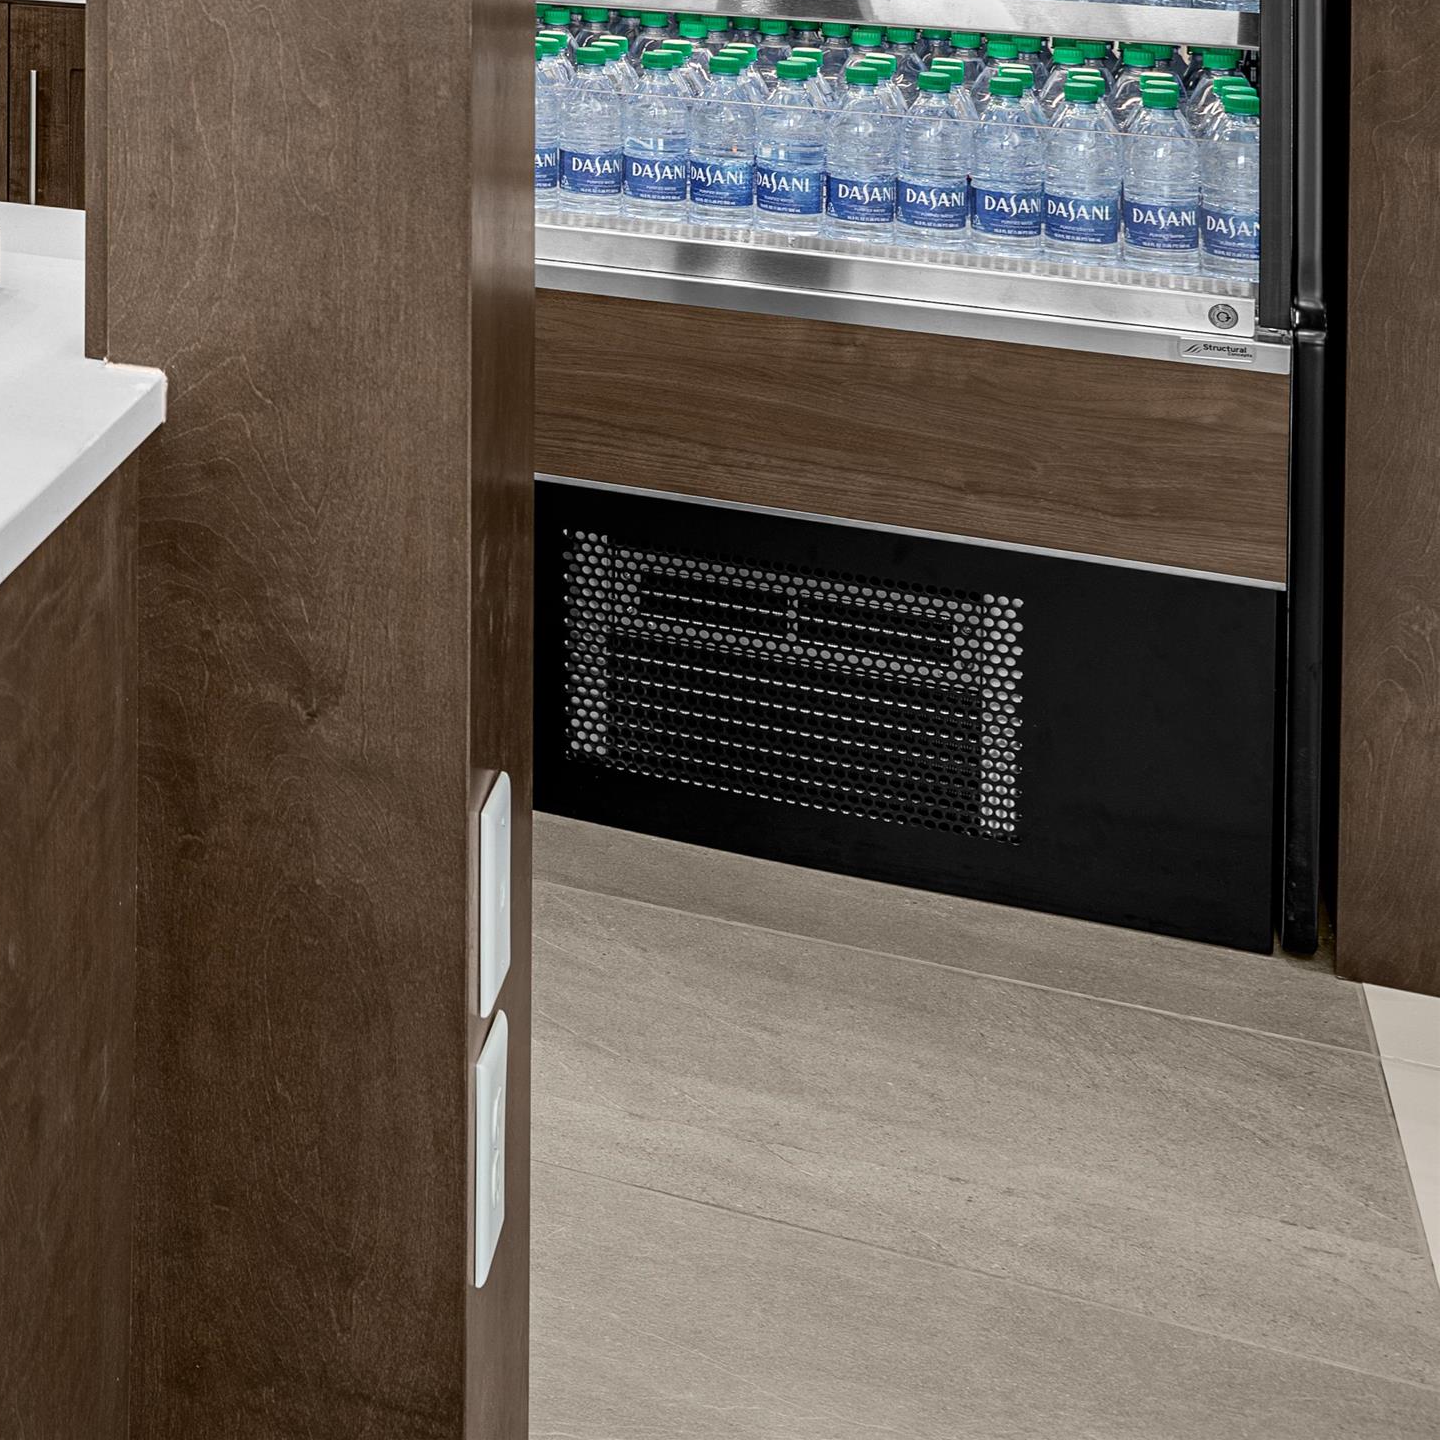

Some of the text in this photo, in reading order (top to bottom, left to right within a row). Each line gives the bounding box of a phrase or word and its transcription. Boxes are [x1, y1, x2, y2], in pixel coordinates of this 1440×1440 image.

[691, 164, 744, 185] DASANI
[1048, 198, 1109, 220] DASANI
[1133, 206, 1196, 229] DASANI
[1203, 344, 1247, 354] Structural
